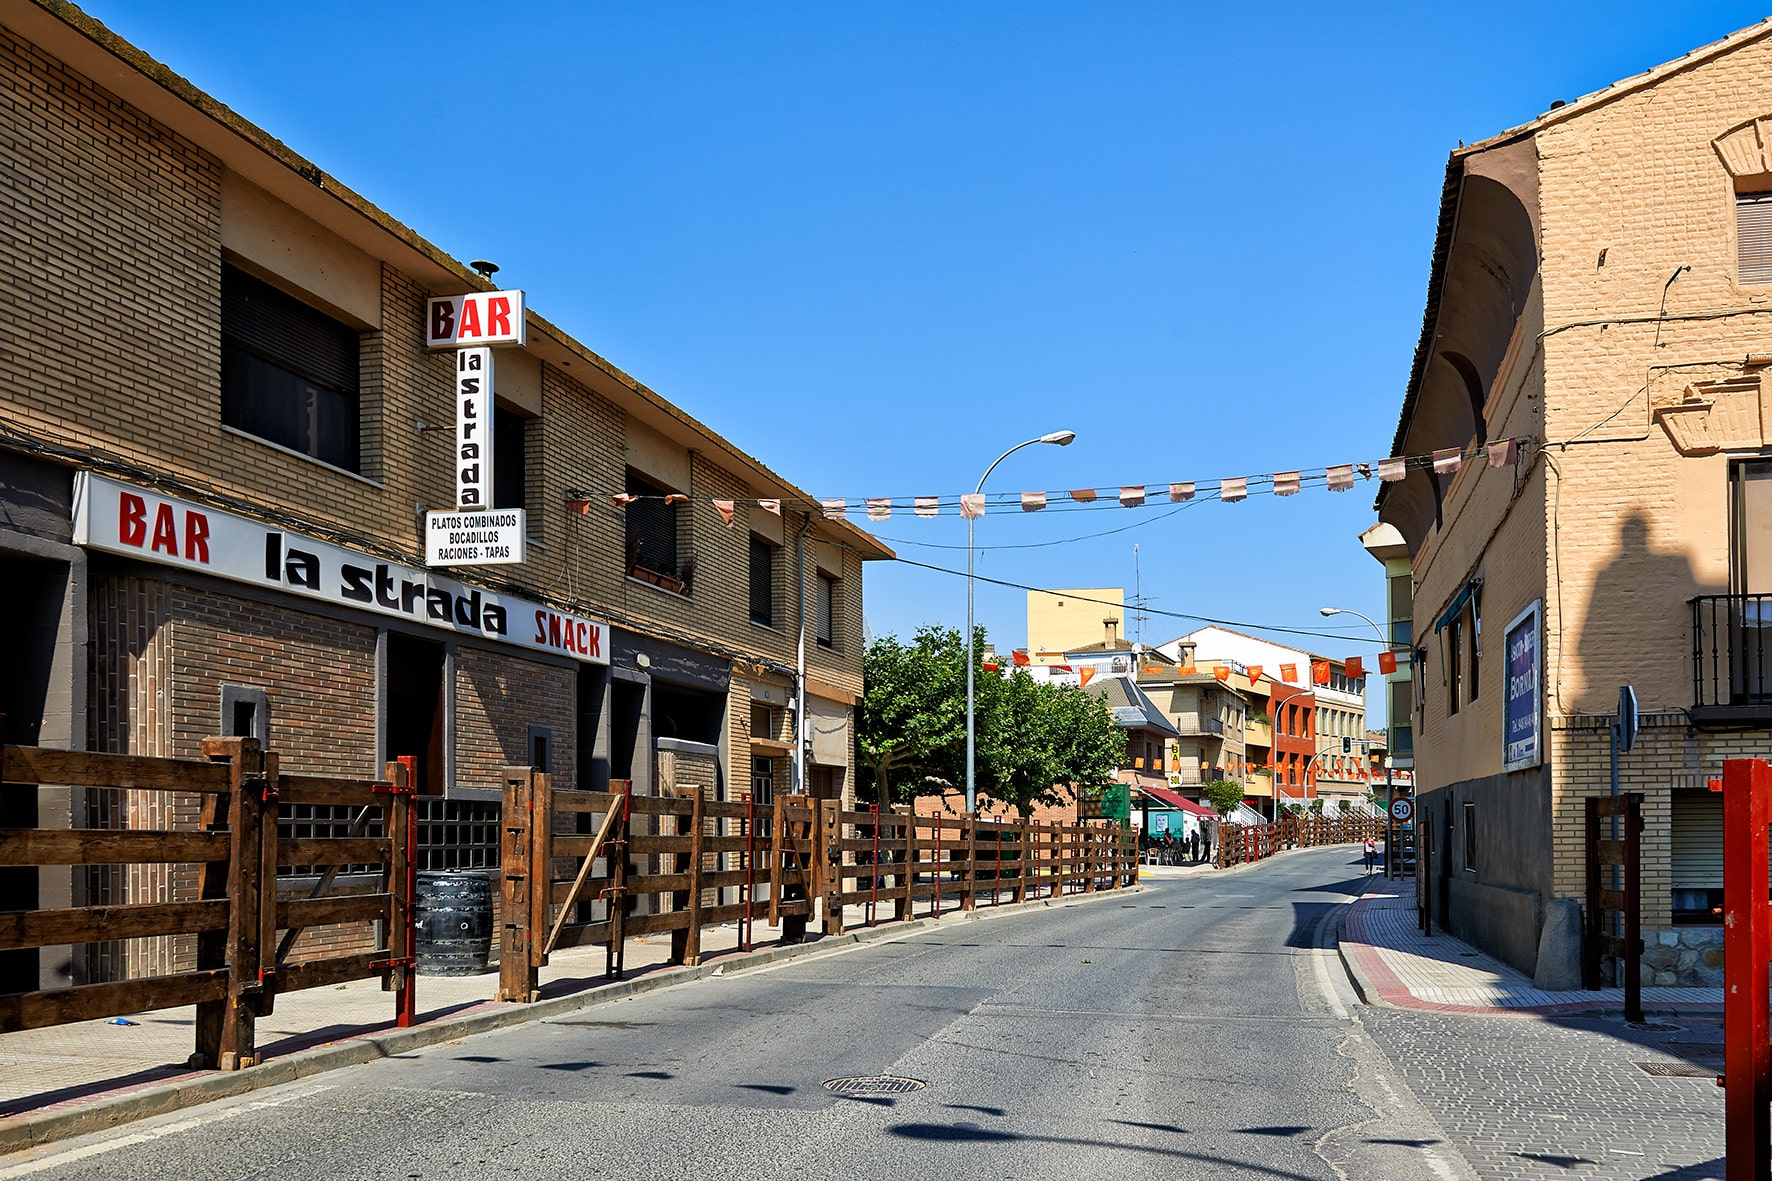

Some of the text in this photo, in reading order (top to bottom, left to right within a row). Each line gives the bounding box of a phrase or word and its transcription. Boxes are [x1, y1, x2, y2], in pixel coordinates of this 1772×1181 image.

[432, 297, 511, 340] BAR
[460, 352, 481, 371] la
[461, 378, 480, 505] strada
[119, 491, 209, 563] BAR
[432, 515, 516, 529] PLATOS COMBINADOS
[450, 531, 499, 544] BOCADILLOS
[439, 547, 478, 560] RACIONES
[485, 546, 510, 558] TAPAS
[266, 532, 507, 636] la strada
[534, 610, 601, 658] SNACK
[1171, 775, 1180, 784] SOL
[1394, 804, 1409, 815] 50
